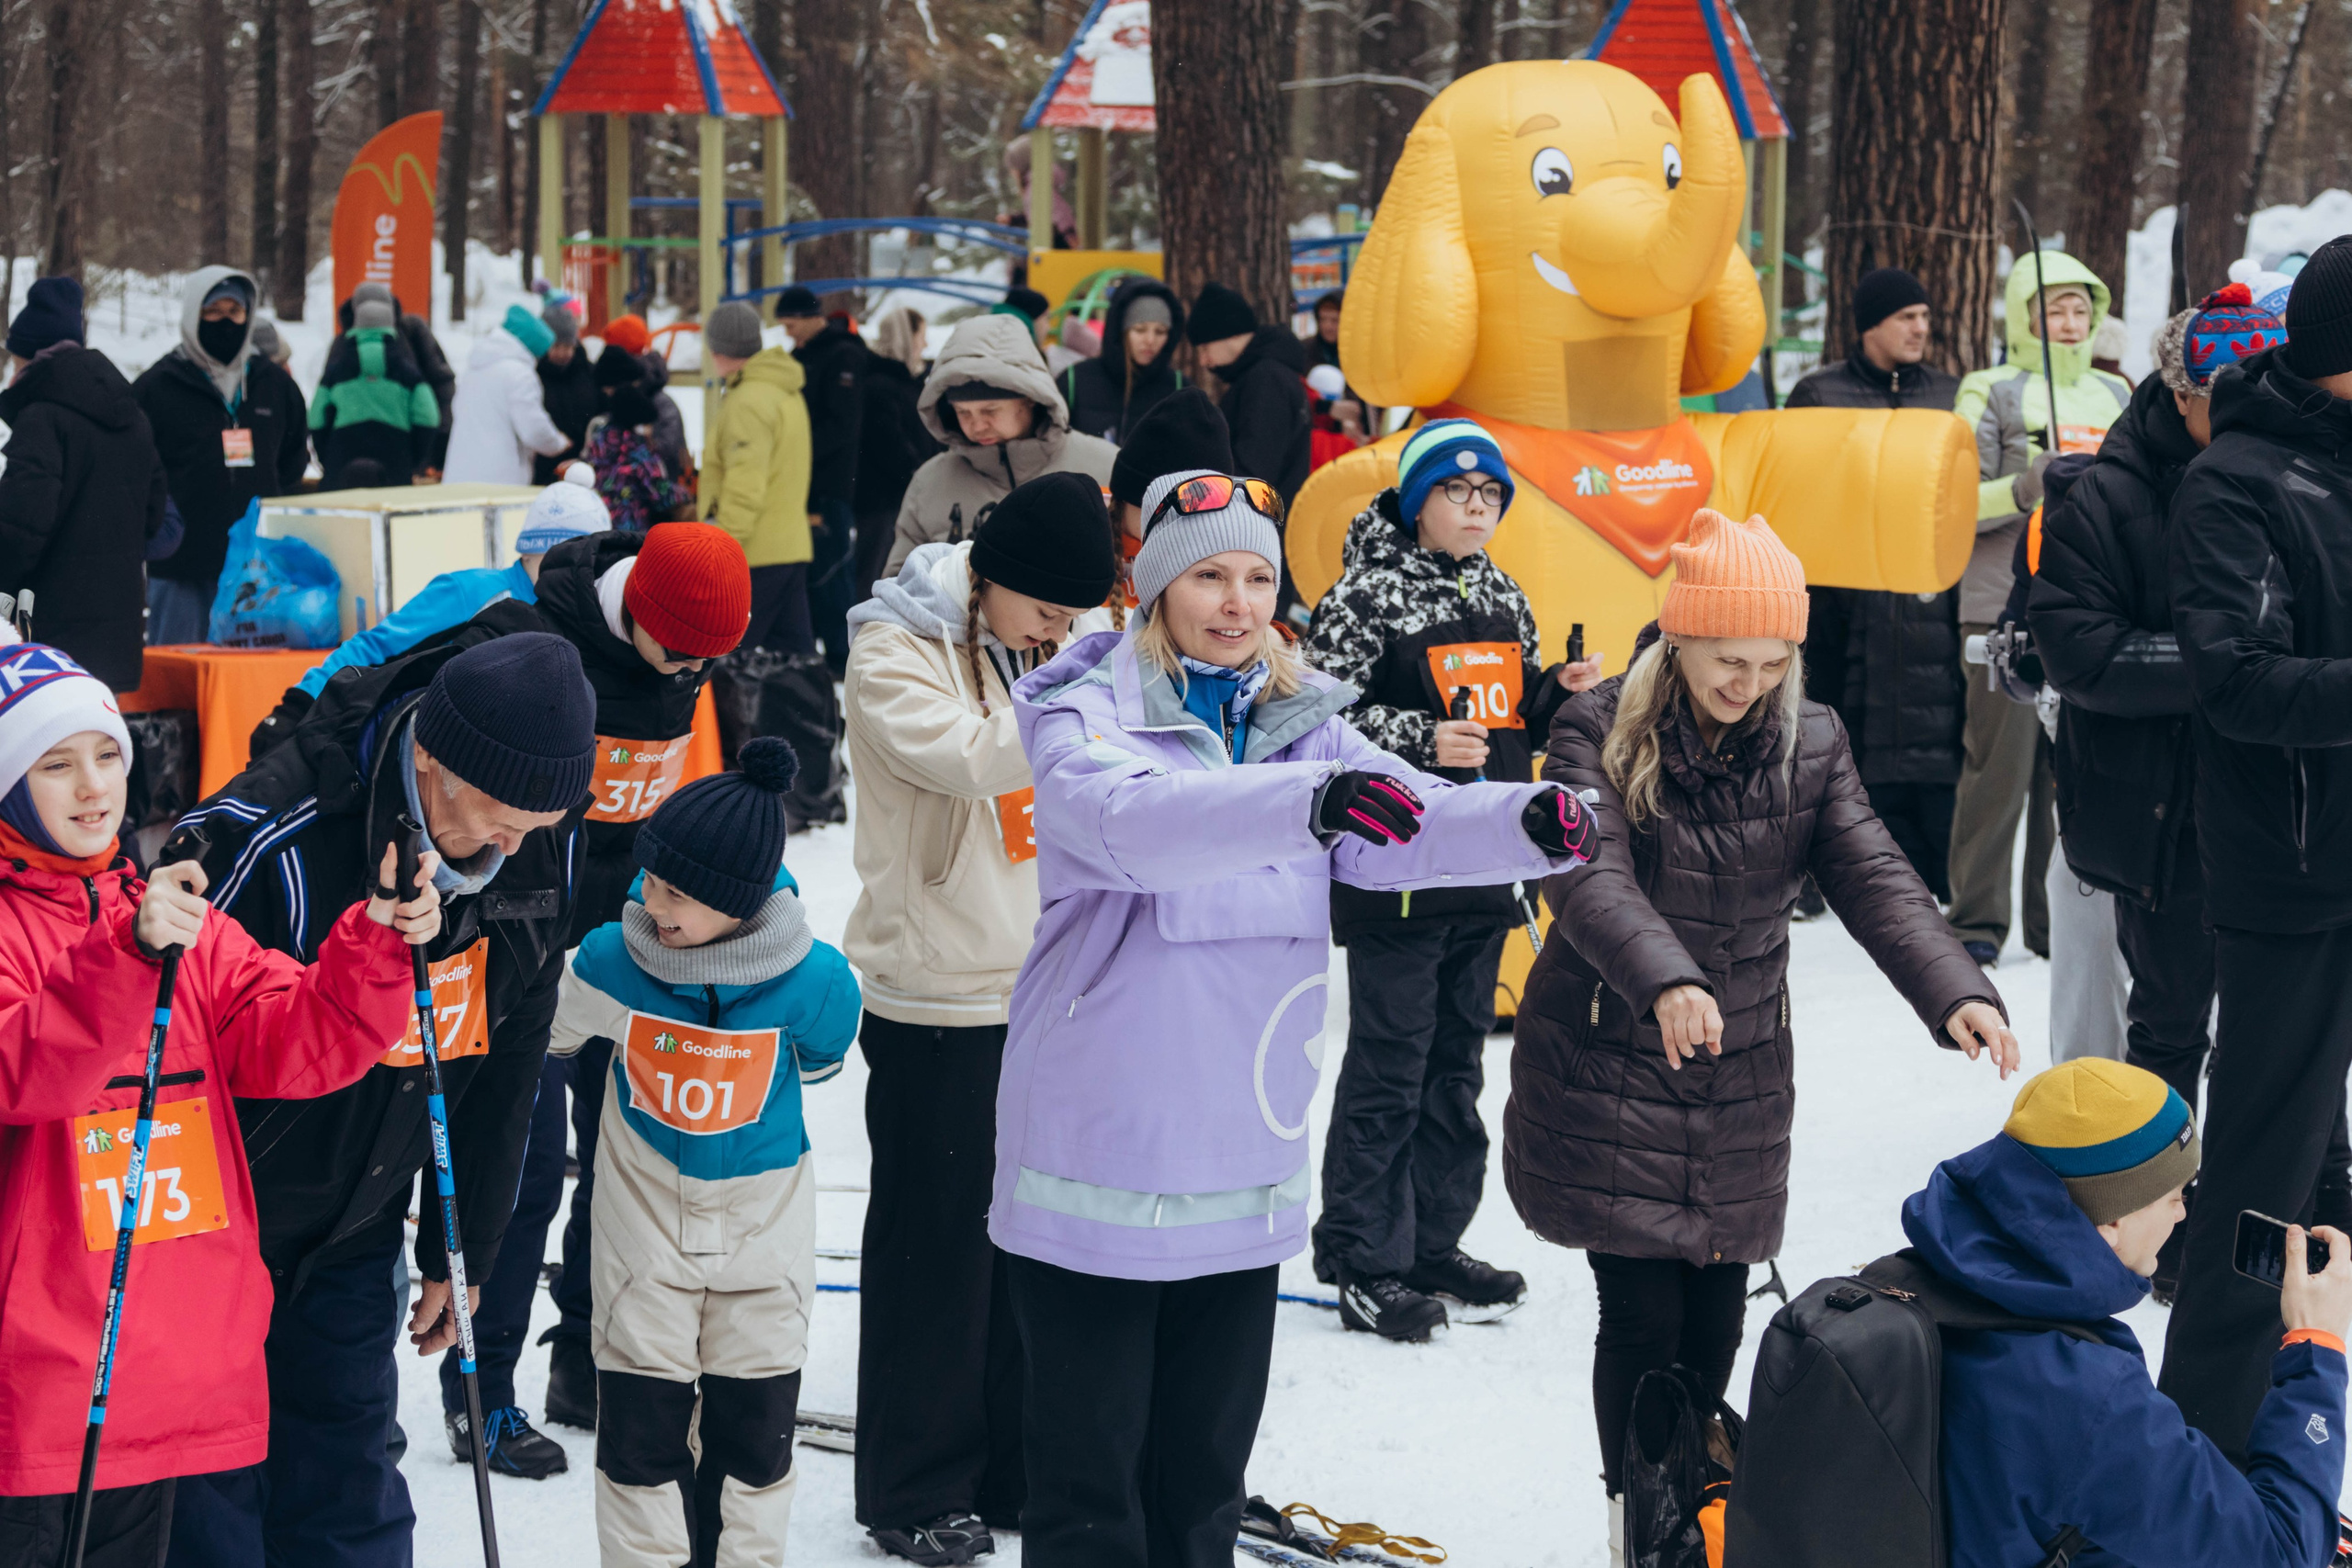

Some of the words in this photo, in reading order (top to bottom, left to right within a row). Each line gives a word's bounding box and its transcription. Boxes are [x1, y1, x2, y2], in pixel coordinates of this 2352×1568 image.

[366, 214, 397, 290] line
[1615, 459, 1693, 482] Goodline
[1464, 652, 1503, 665] Goodline
[596, 777, 665, 813] 315
[429, 964, 472, 987] oodline
[682, 1041, 751, 1058] Goodline
[657, 1071, 734, 1120] 101
[432, 1121, 448, 1168] SWIFT
[125, 1145, 145, 1198] SWIFT
